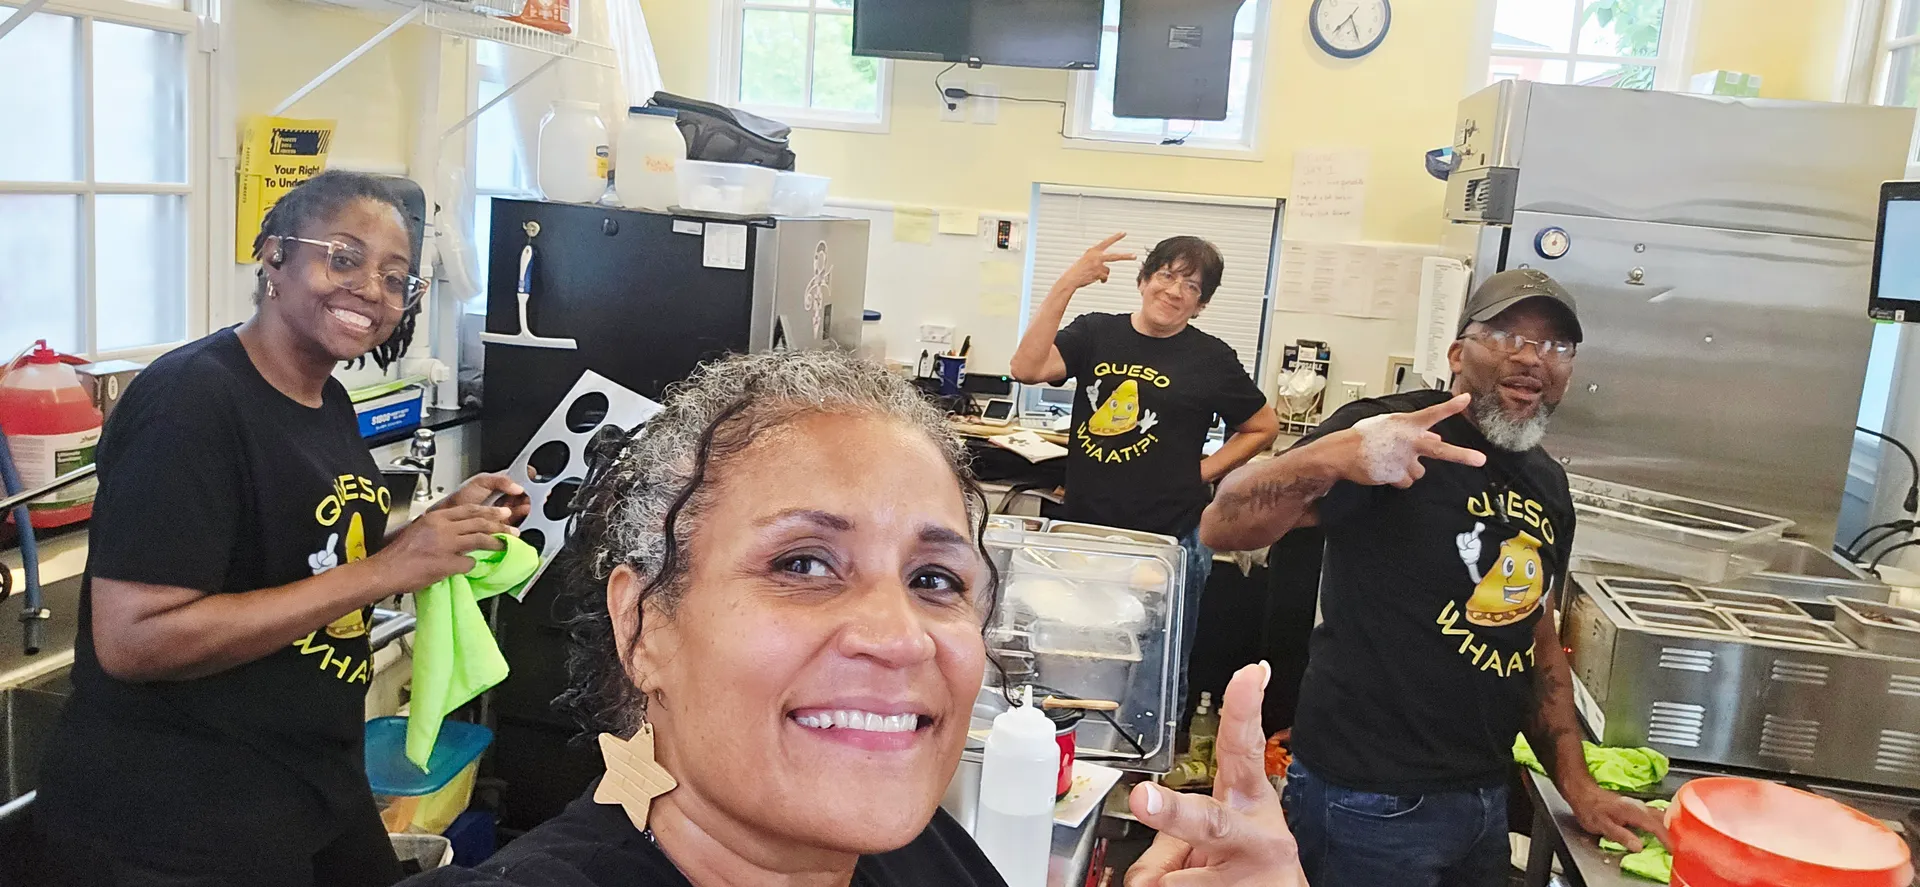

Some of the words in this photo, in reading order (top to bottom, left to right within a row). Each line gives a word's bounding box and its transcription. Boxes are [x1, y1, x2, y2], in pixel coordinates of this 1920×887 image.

[264, 178, 276, 188] To
[279, 178, 298, 188] Und
[274, 164, 296, 175] Your
[298, 165, 320, 176] Right
[1094, 362, 1171, 388] QUESO
[1076, 421, 1159, 463] WHAAT!?!
[293, 630, 369, 684] WHA
